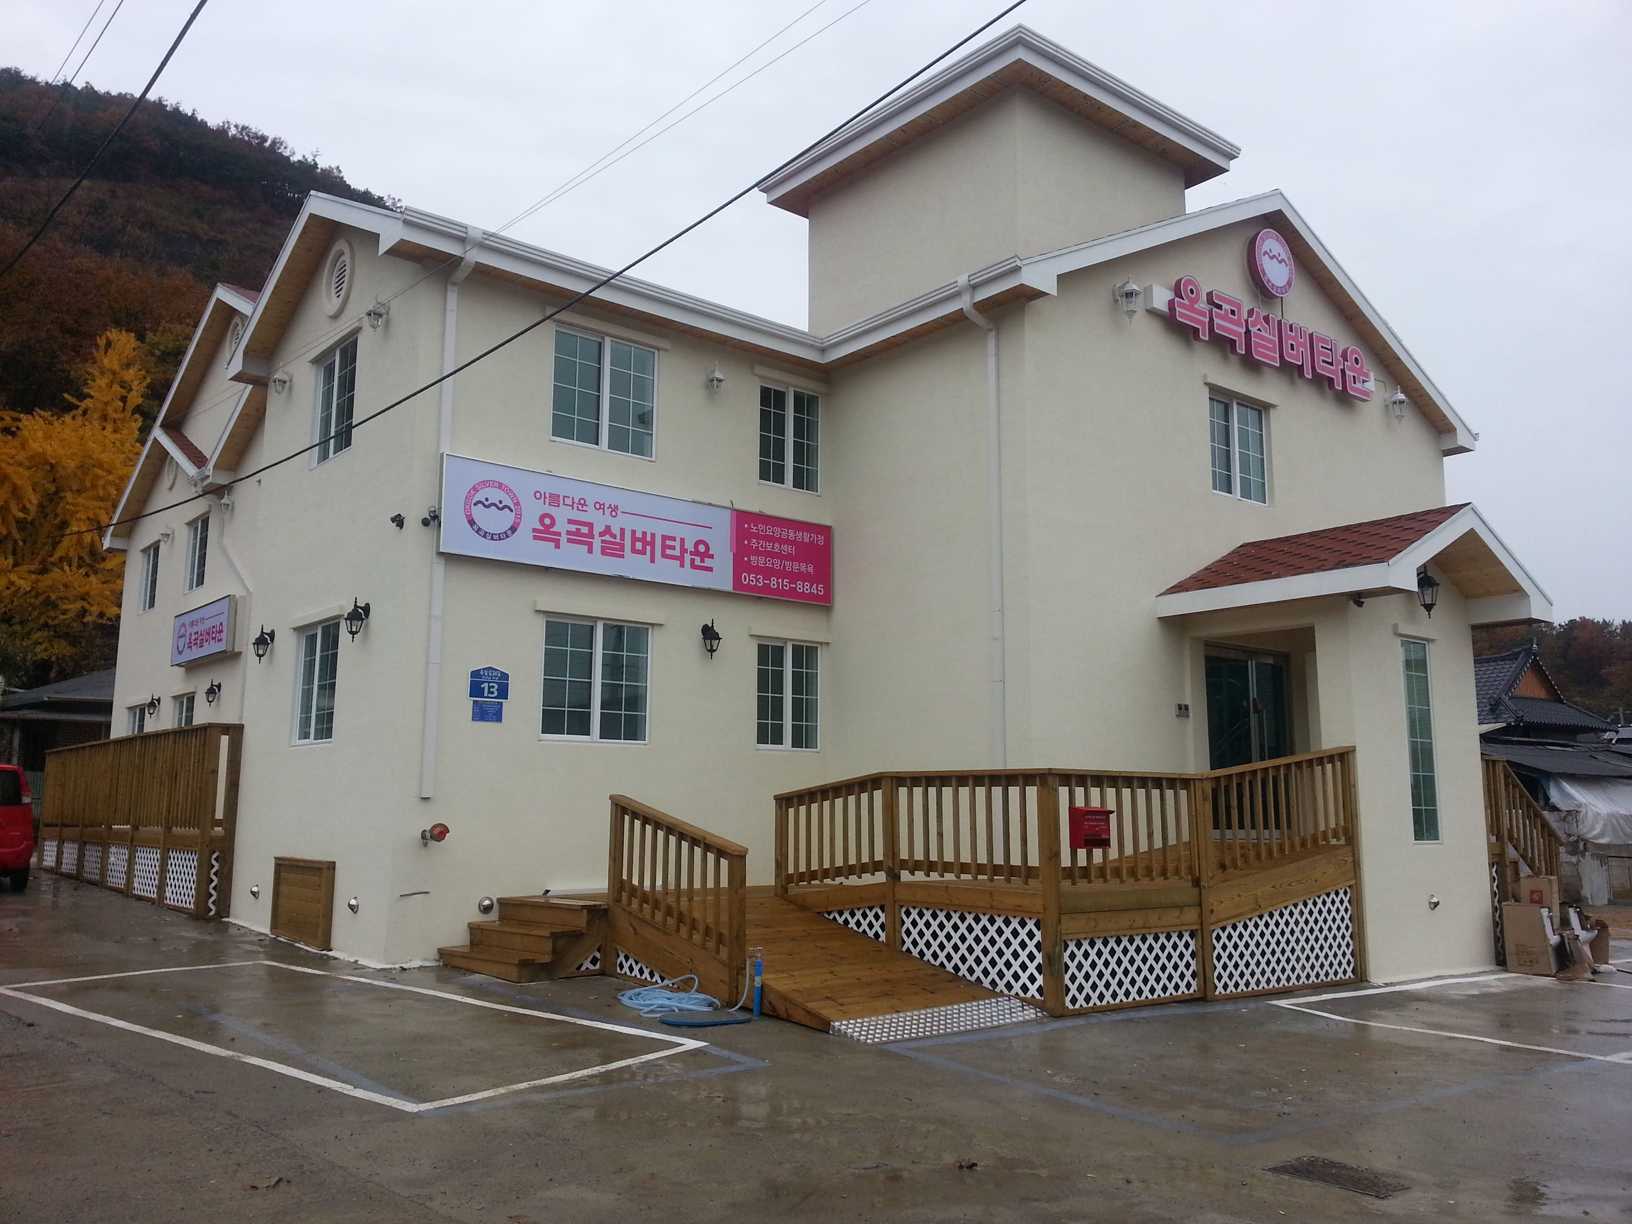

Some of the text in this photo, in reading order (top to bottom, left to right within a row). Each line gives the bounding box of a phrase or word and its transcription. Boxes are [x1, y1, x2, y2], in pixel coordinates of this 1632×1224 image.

[1170, 275, 1373, 401] 옥곡실버타운
[533, 490, 619, 518] 아름다운 여생
[531, 512, 715, 573] 옥곡실버타운
[750, 538, 795, 556] 주간보호센터
[741, 572, 824, 595] 053-815-8845
[481, 682, 498, 697] 13
